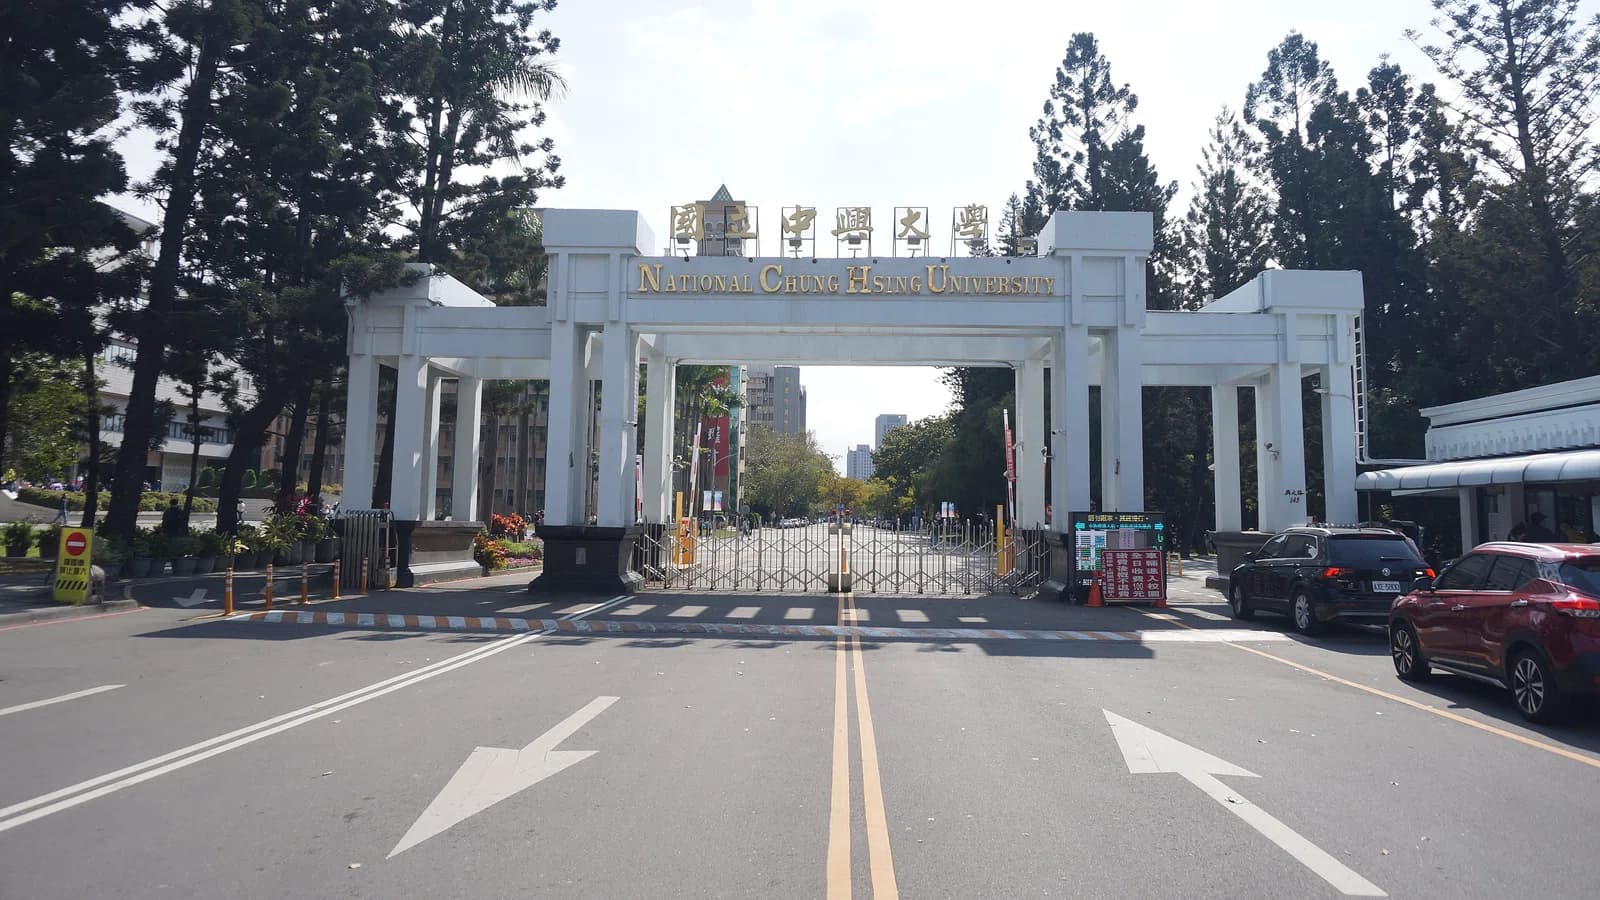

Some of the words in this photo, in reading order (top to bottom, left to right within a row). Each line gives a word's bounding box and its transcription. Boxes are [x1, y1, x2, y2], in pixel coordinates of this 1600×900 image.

[670, 203, 987, 247] 國立中興大學
[638, 263, 753, 293] NATIONAL
[759, 264, 840, 294] CHUNG
[846, 265, 921, 295] HSING
[926, 264, 1056, 296] UNIVERSITY
